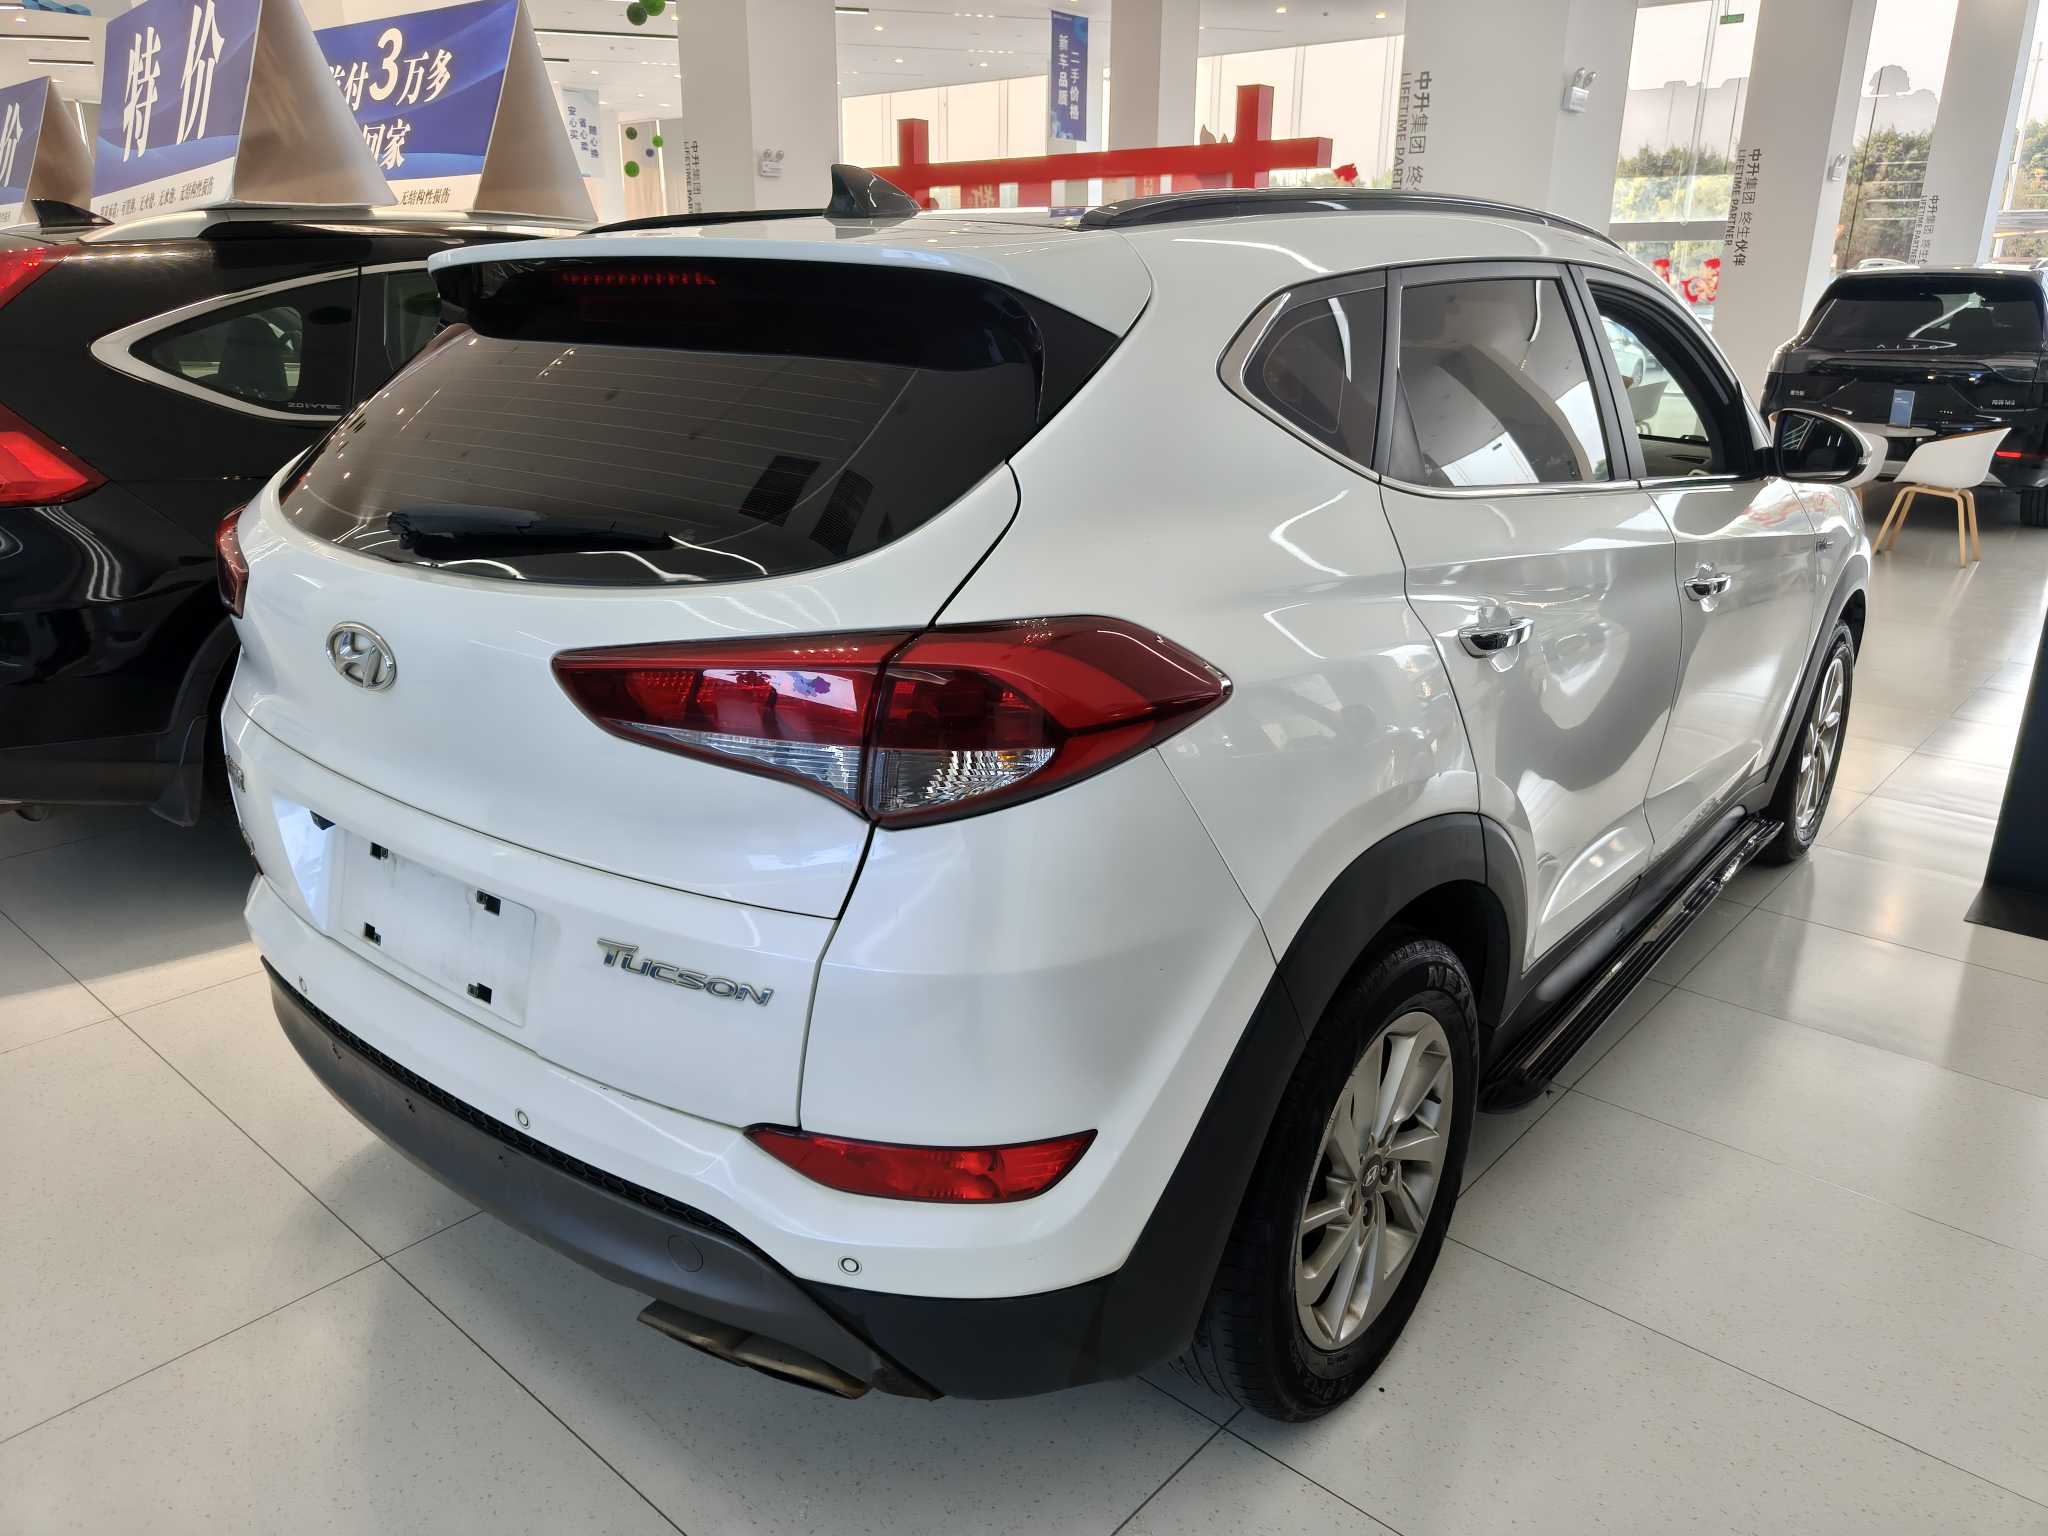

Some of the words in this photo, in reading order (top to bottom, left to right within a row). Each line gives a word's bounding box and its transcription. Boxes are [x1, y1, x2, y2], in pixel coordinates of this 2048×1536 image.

[122, 0, 225, 162] 特价
[1396, 73, 1412, 141] LIFETIME
[1409, 71, 1432, 154] 中升集团
[1733, 149, 1746, 197] LIFETIME
[1741, 148, 1762, 204] 中升集团
[1724, 199, 1739, 246] PARTNER
[1733, 211, 1752, 267] 终生伙伴
[597, 938, 775, 1007] TUCSON
